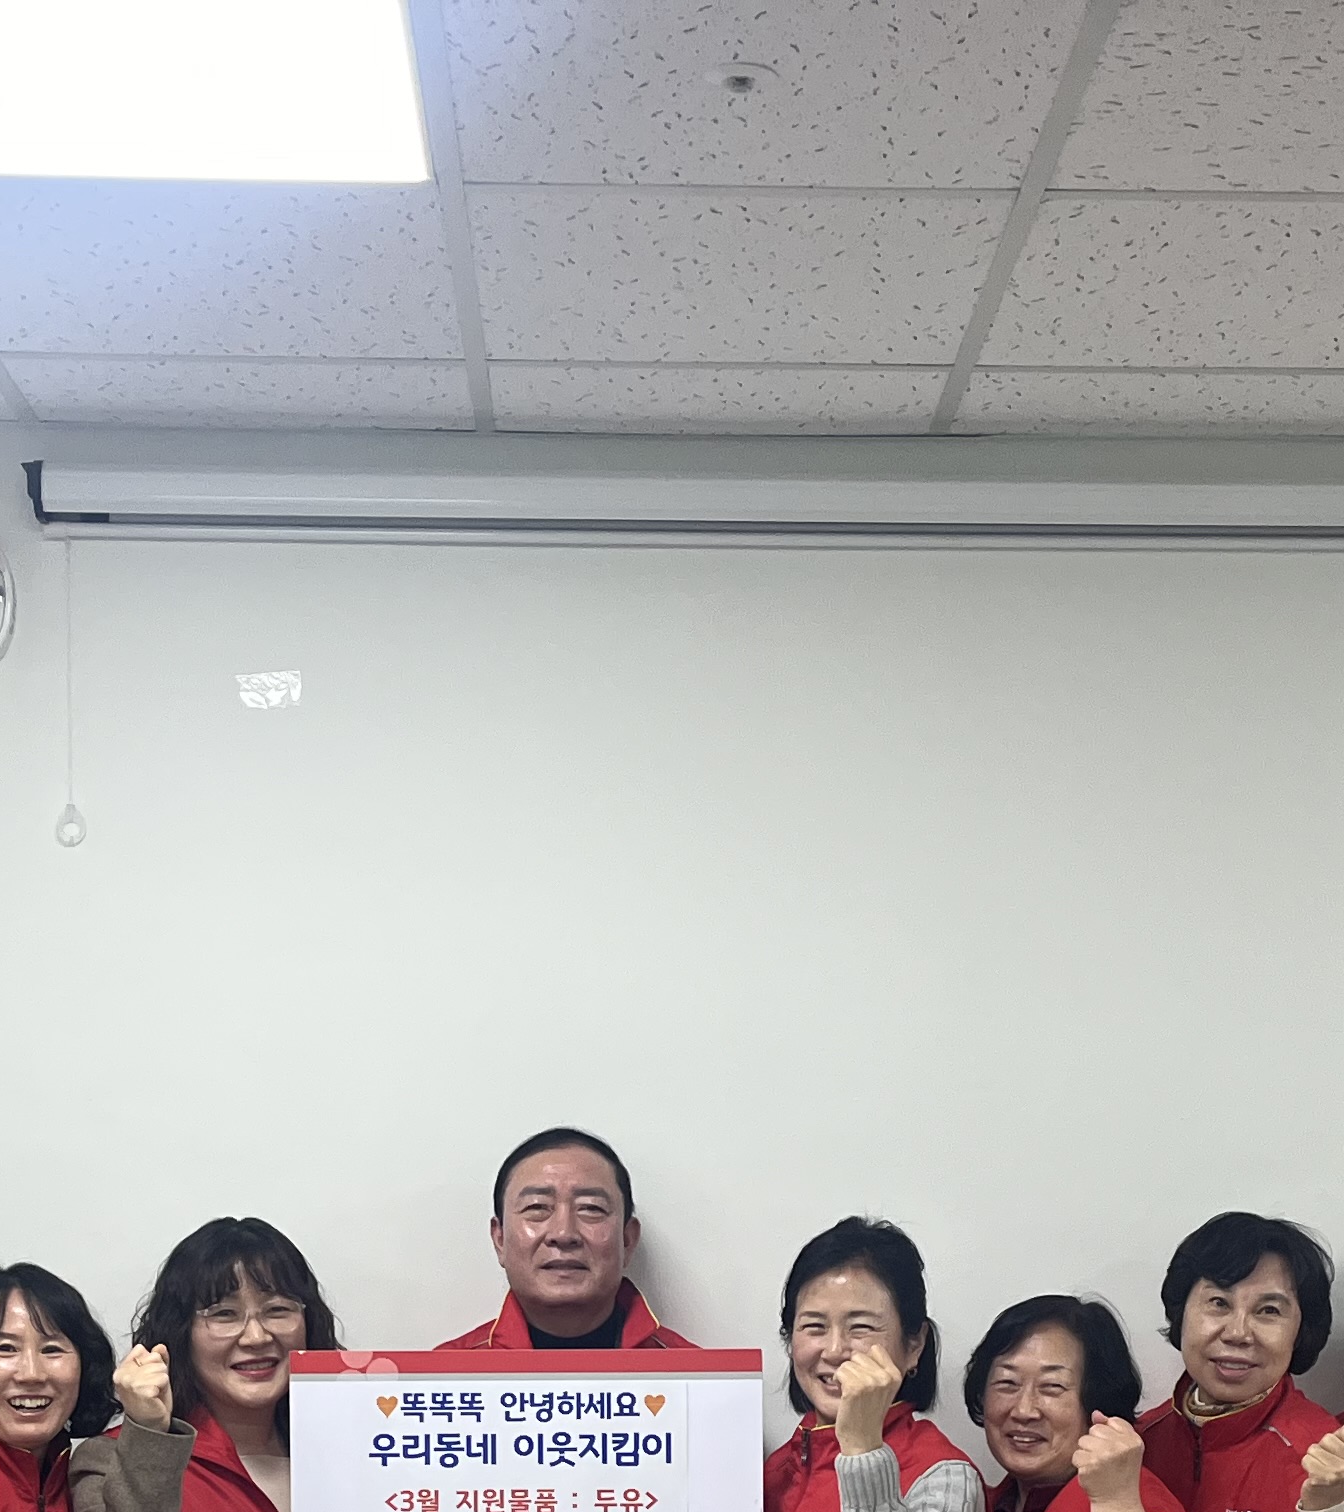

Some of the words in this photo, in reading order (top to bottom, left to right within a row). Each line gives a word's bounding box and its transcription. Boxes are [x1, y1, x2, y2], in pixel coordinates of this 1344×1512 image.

[399, 1392, 486, 1424] 똑똑똑
[499, 1390, 641, 1424] 안녕하세요
[368, 1432, 498, 1469] 우리동네
[513, 1431, 673, 1468] 이웃지킴이
